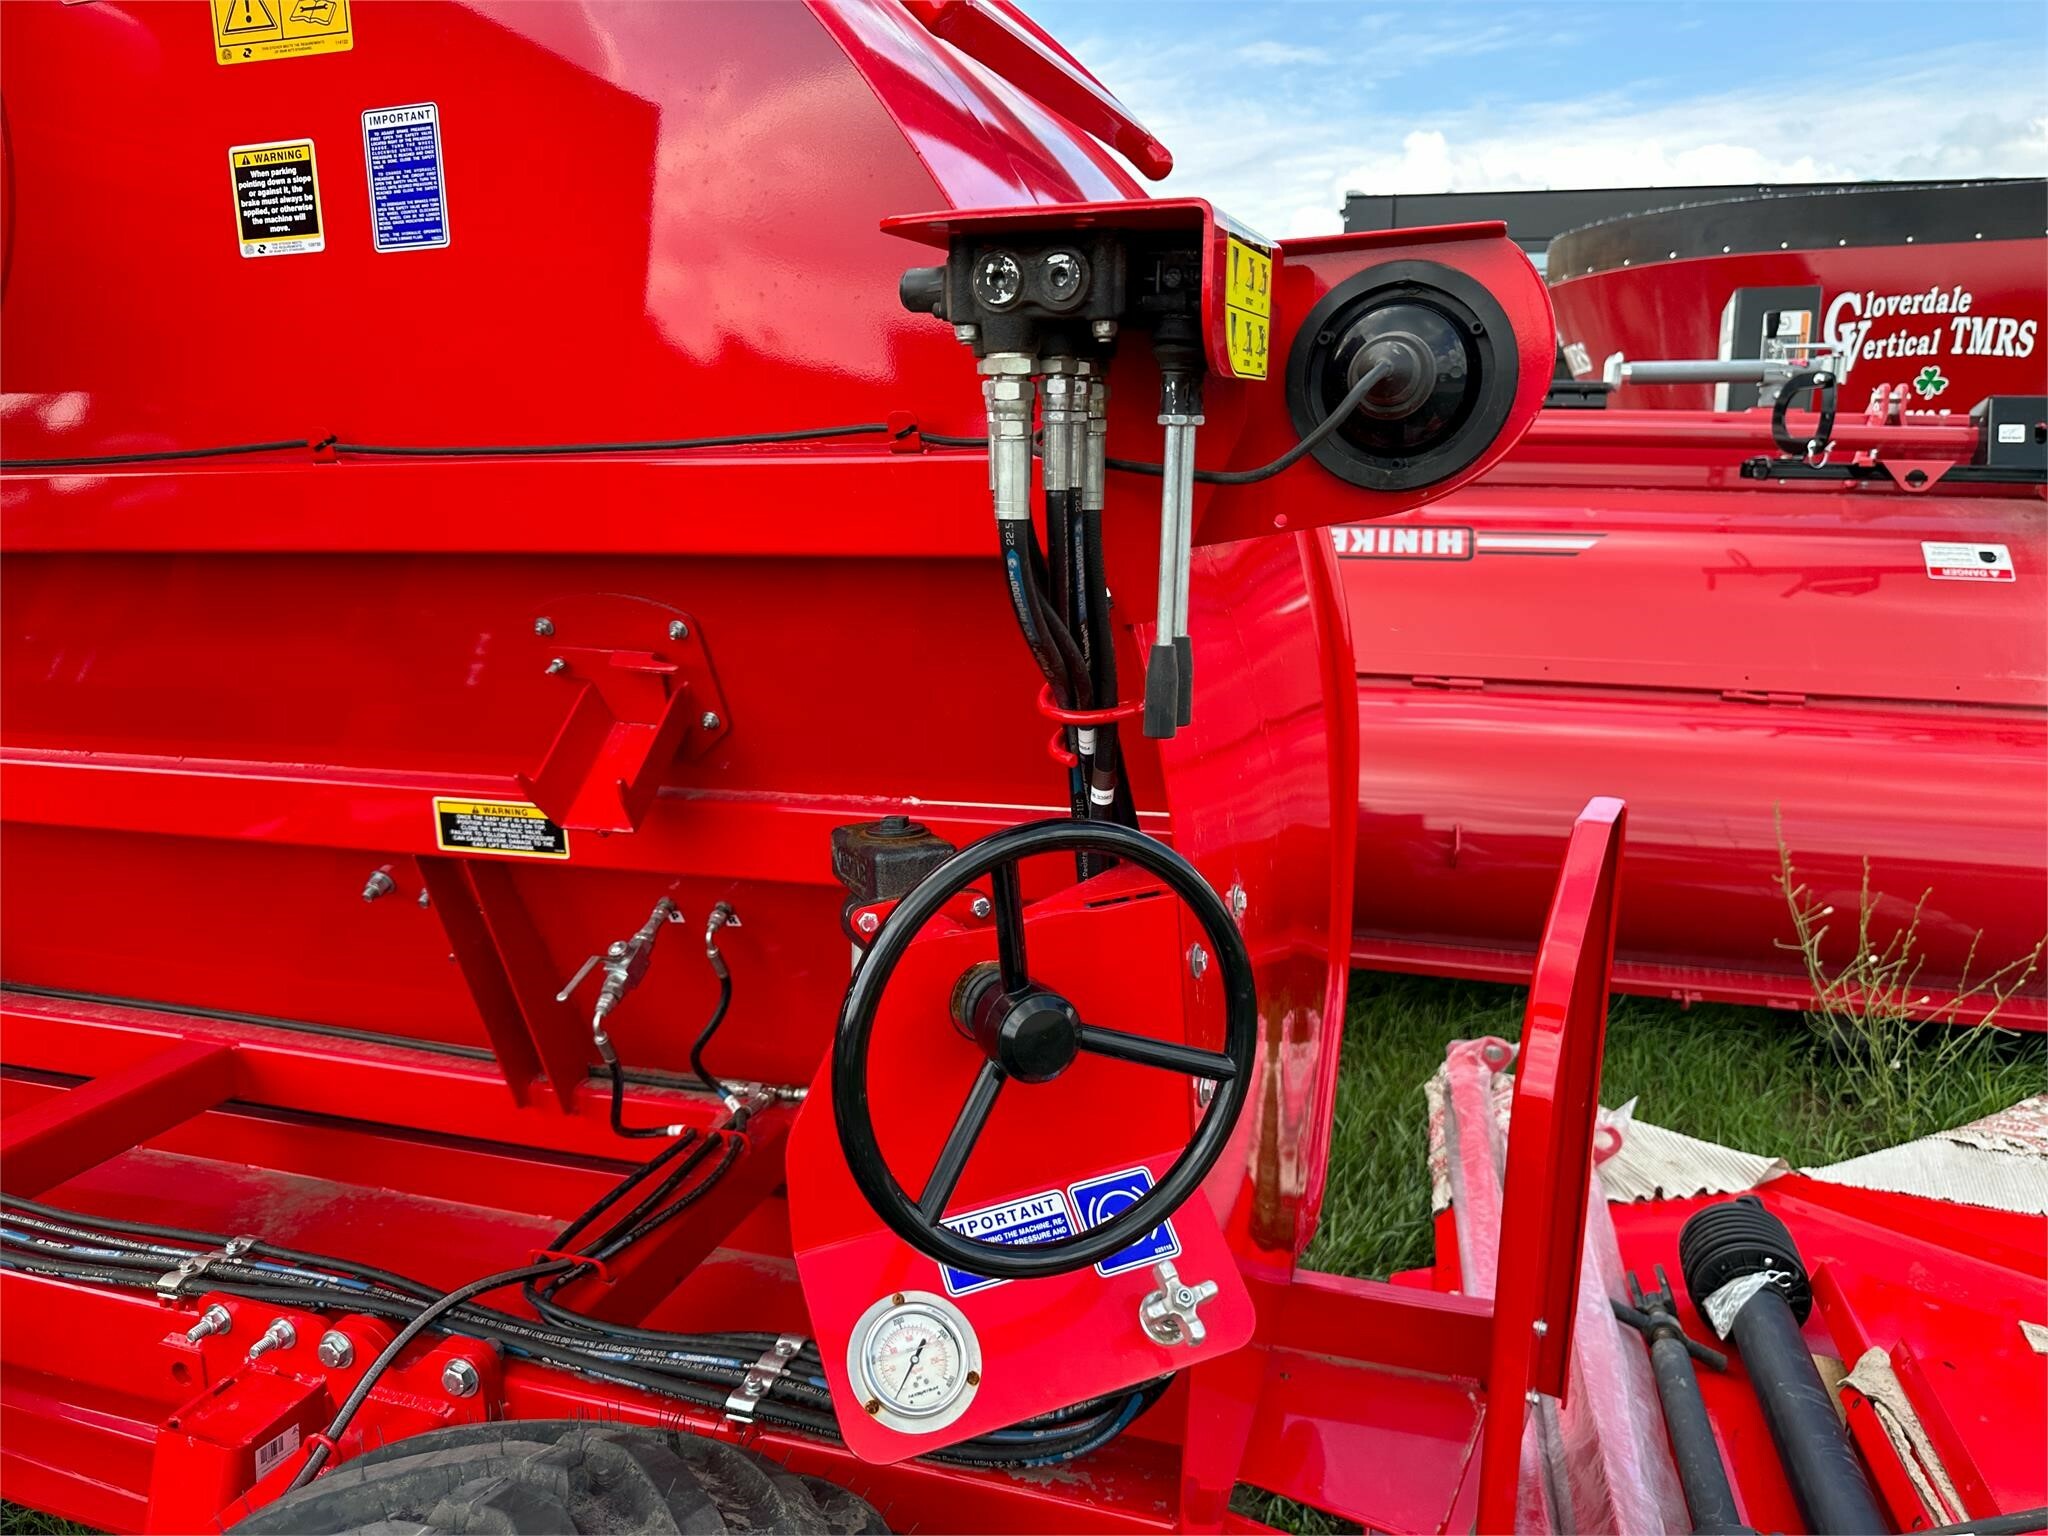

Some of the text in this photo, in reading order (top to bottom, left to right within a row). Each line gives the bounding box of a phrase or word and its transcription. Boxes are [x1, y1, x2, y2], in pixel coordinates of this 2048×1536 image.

[369, 110, 430, 125] IMPORTANT
[254, 150, 302, 163] WARNING
[250, 167, 297, 178] When parking
[239, 180, 266, 190] pointing
[293, 175, 311, 184] slope
[258, 187, 282, 197] against
[241, 199, 260, 207] brake
[262, 197, 278, 205] must
[280, 195, 302, 205] always
[244, 207, 270, 218] applied,
[280, 204, 313, 213] otherwise
[265, 215, 292, 224] machine
[1838, 316, 2037, 372] Vertical TMRS
[1005, 522, 1014, 546] 22.5
[1942, 568, 1988, 577] DANGER
[483, 807, 528, 816] WARNING
[950, 1199, 1054, 1235] MPORTANT
[1004, 1230, 1018, 1239] THE
[1019, 1222, 1053, 1236] MACHINE,
[1014, 1233, 1052, 1244] PRESSURE
[1053, 1227, 1067, 1236] AND
